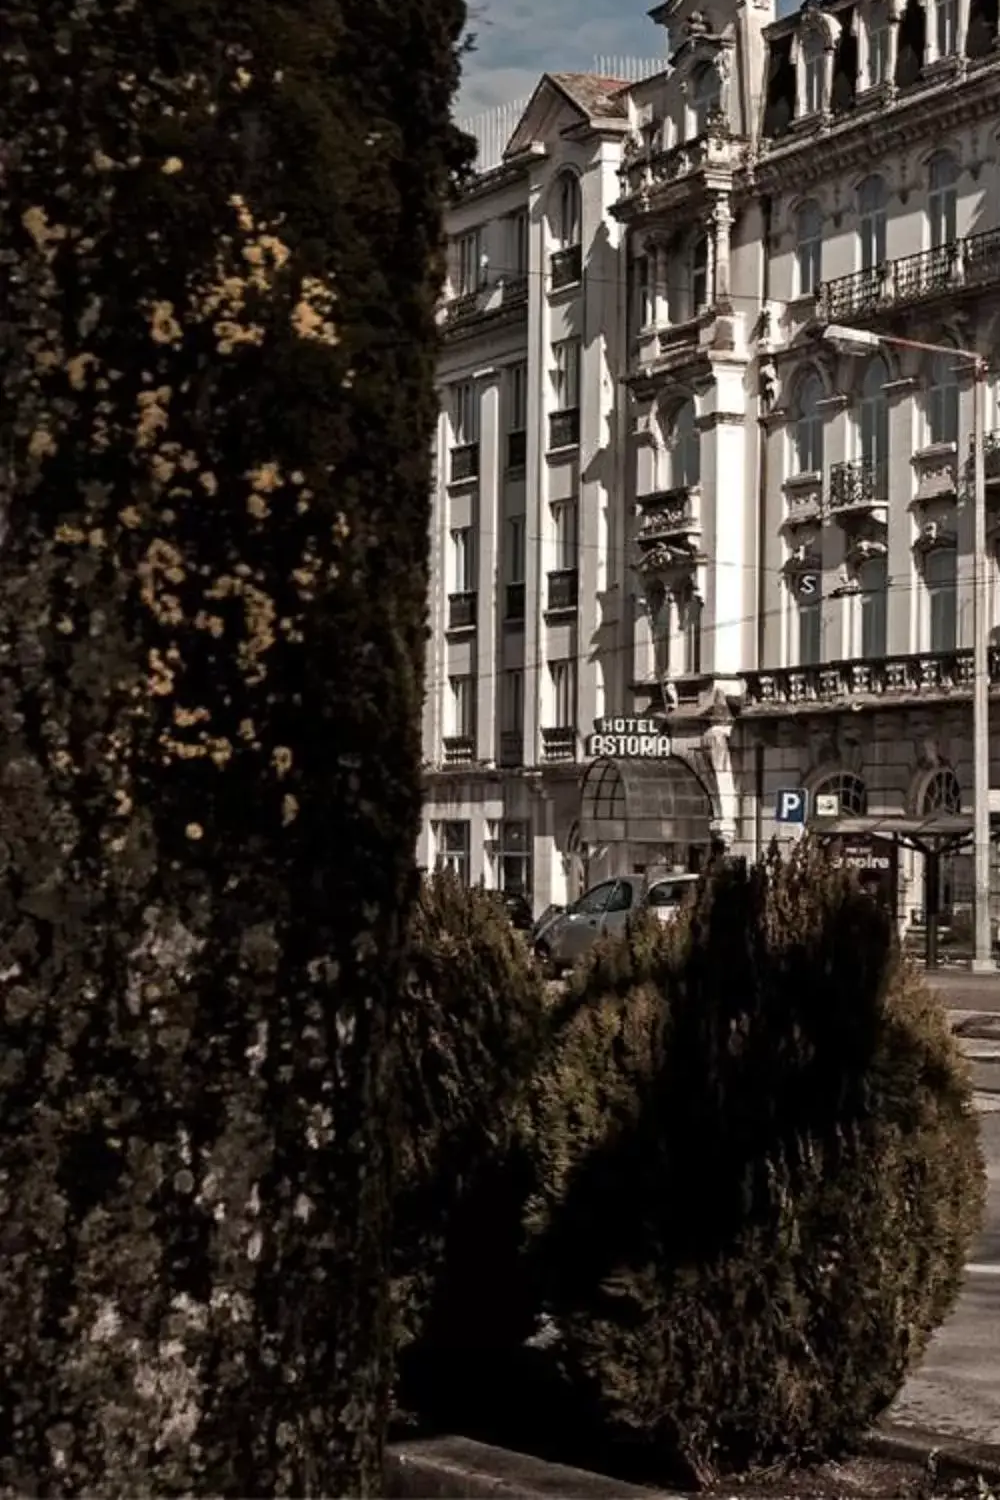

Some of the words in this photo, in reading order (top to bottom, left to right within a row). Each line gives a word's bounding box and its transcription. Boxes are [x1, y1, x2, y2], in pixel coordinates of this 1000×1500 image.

[602, 718, 659, 733] HOTEL
[591, 735, 671, 757] ASTORIA
[782, 793, 801, 818] P
